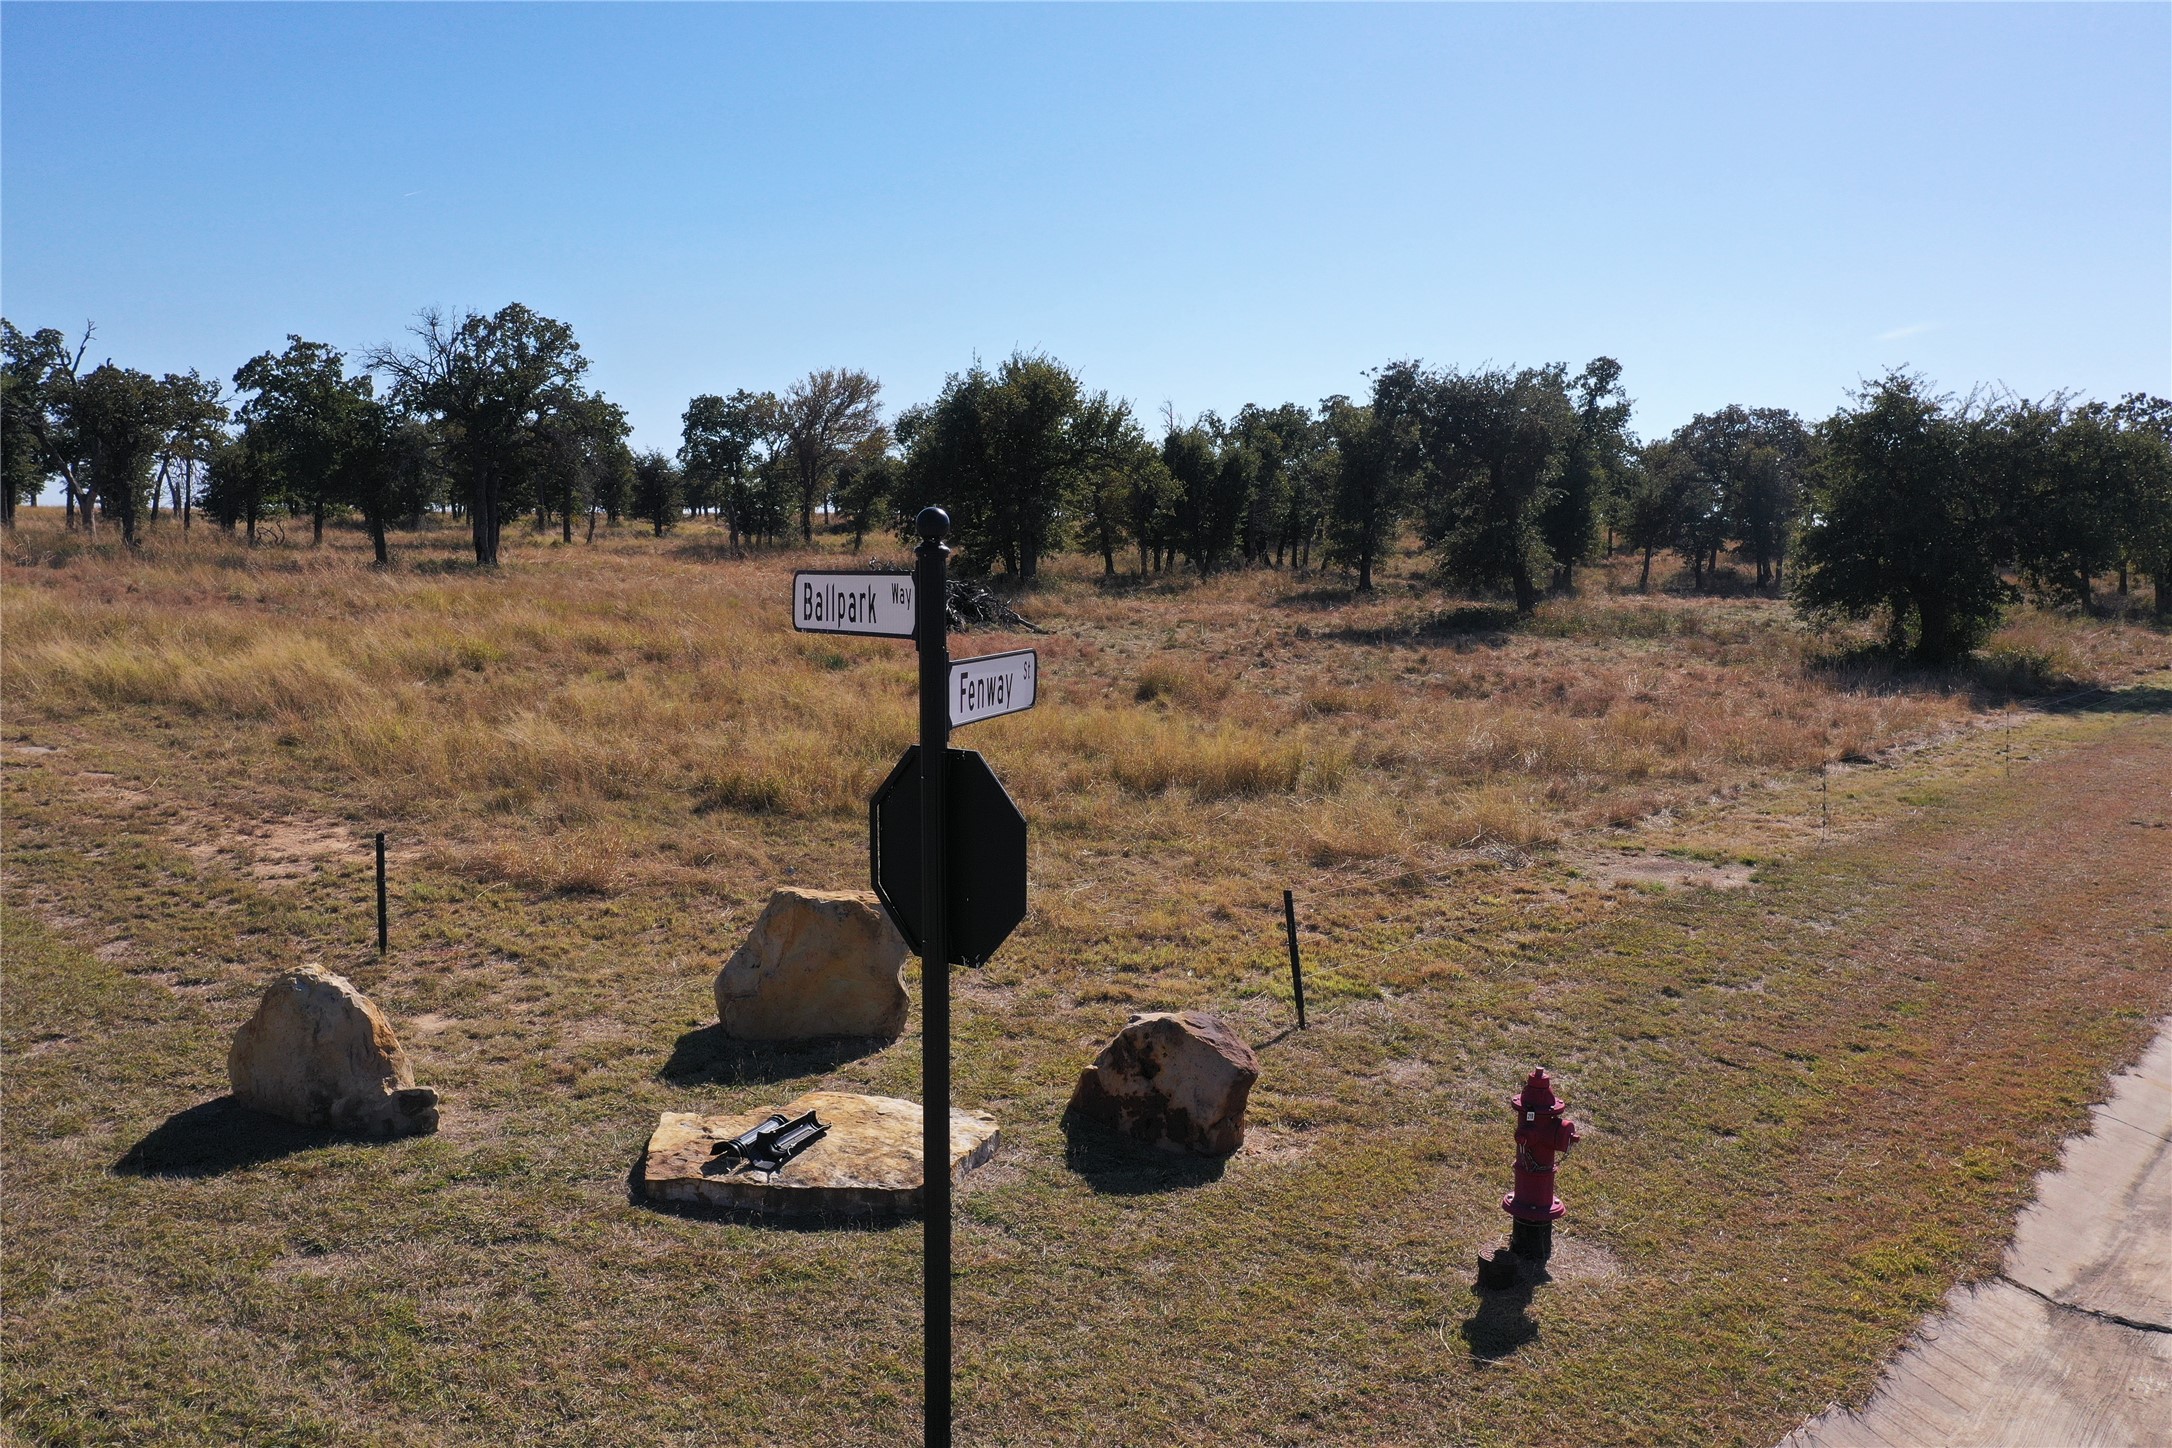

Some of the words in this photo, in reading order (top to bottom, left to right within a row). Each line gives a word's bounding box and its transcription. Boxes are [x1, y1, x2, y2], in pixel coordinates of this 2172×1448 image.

[803, 582, 877, 629] Ballpark
[891, 582, 912, 610] Way
[960, 671, 1013, 714] Fenway
[1023, 660, 1031, 681] St
